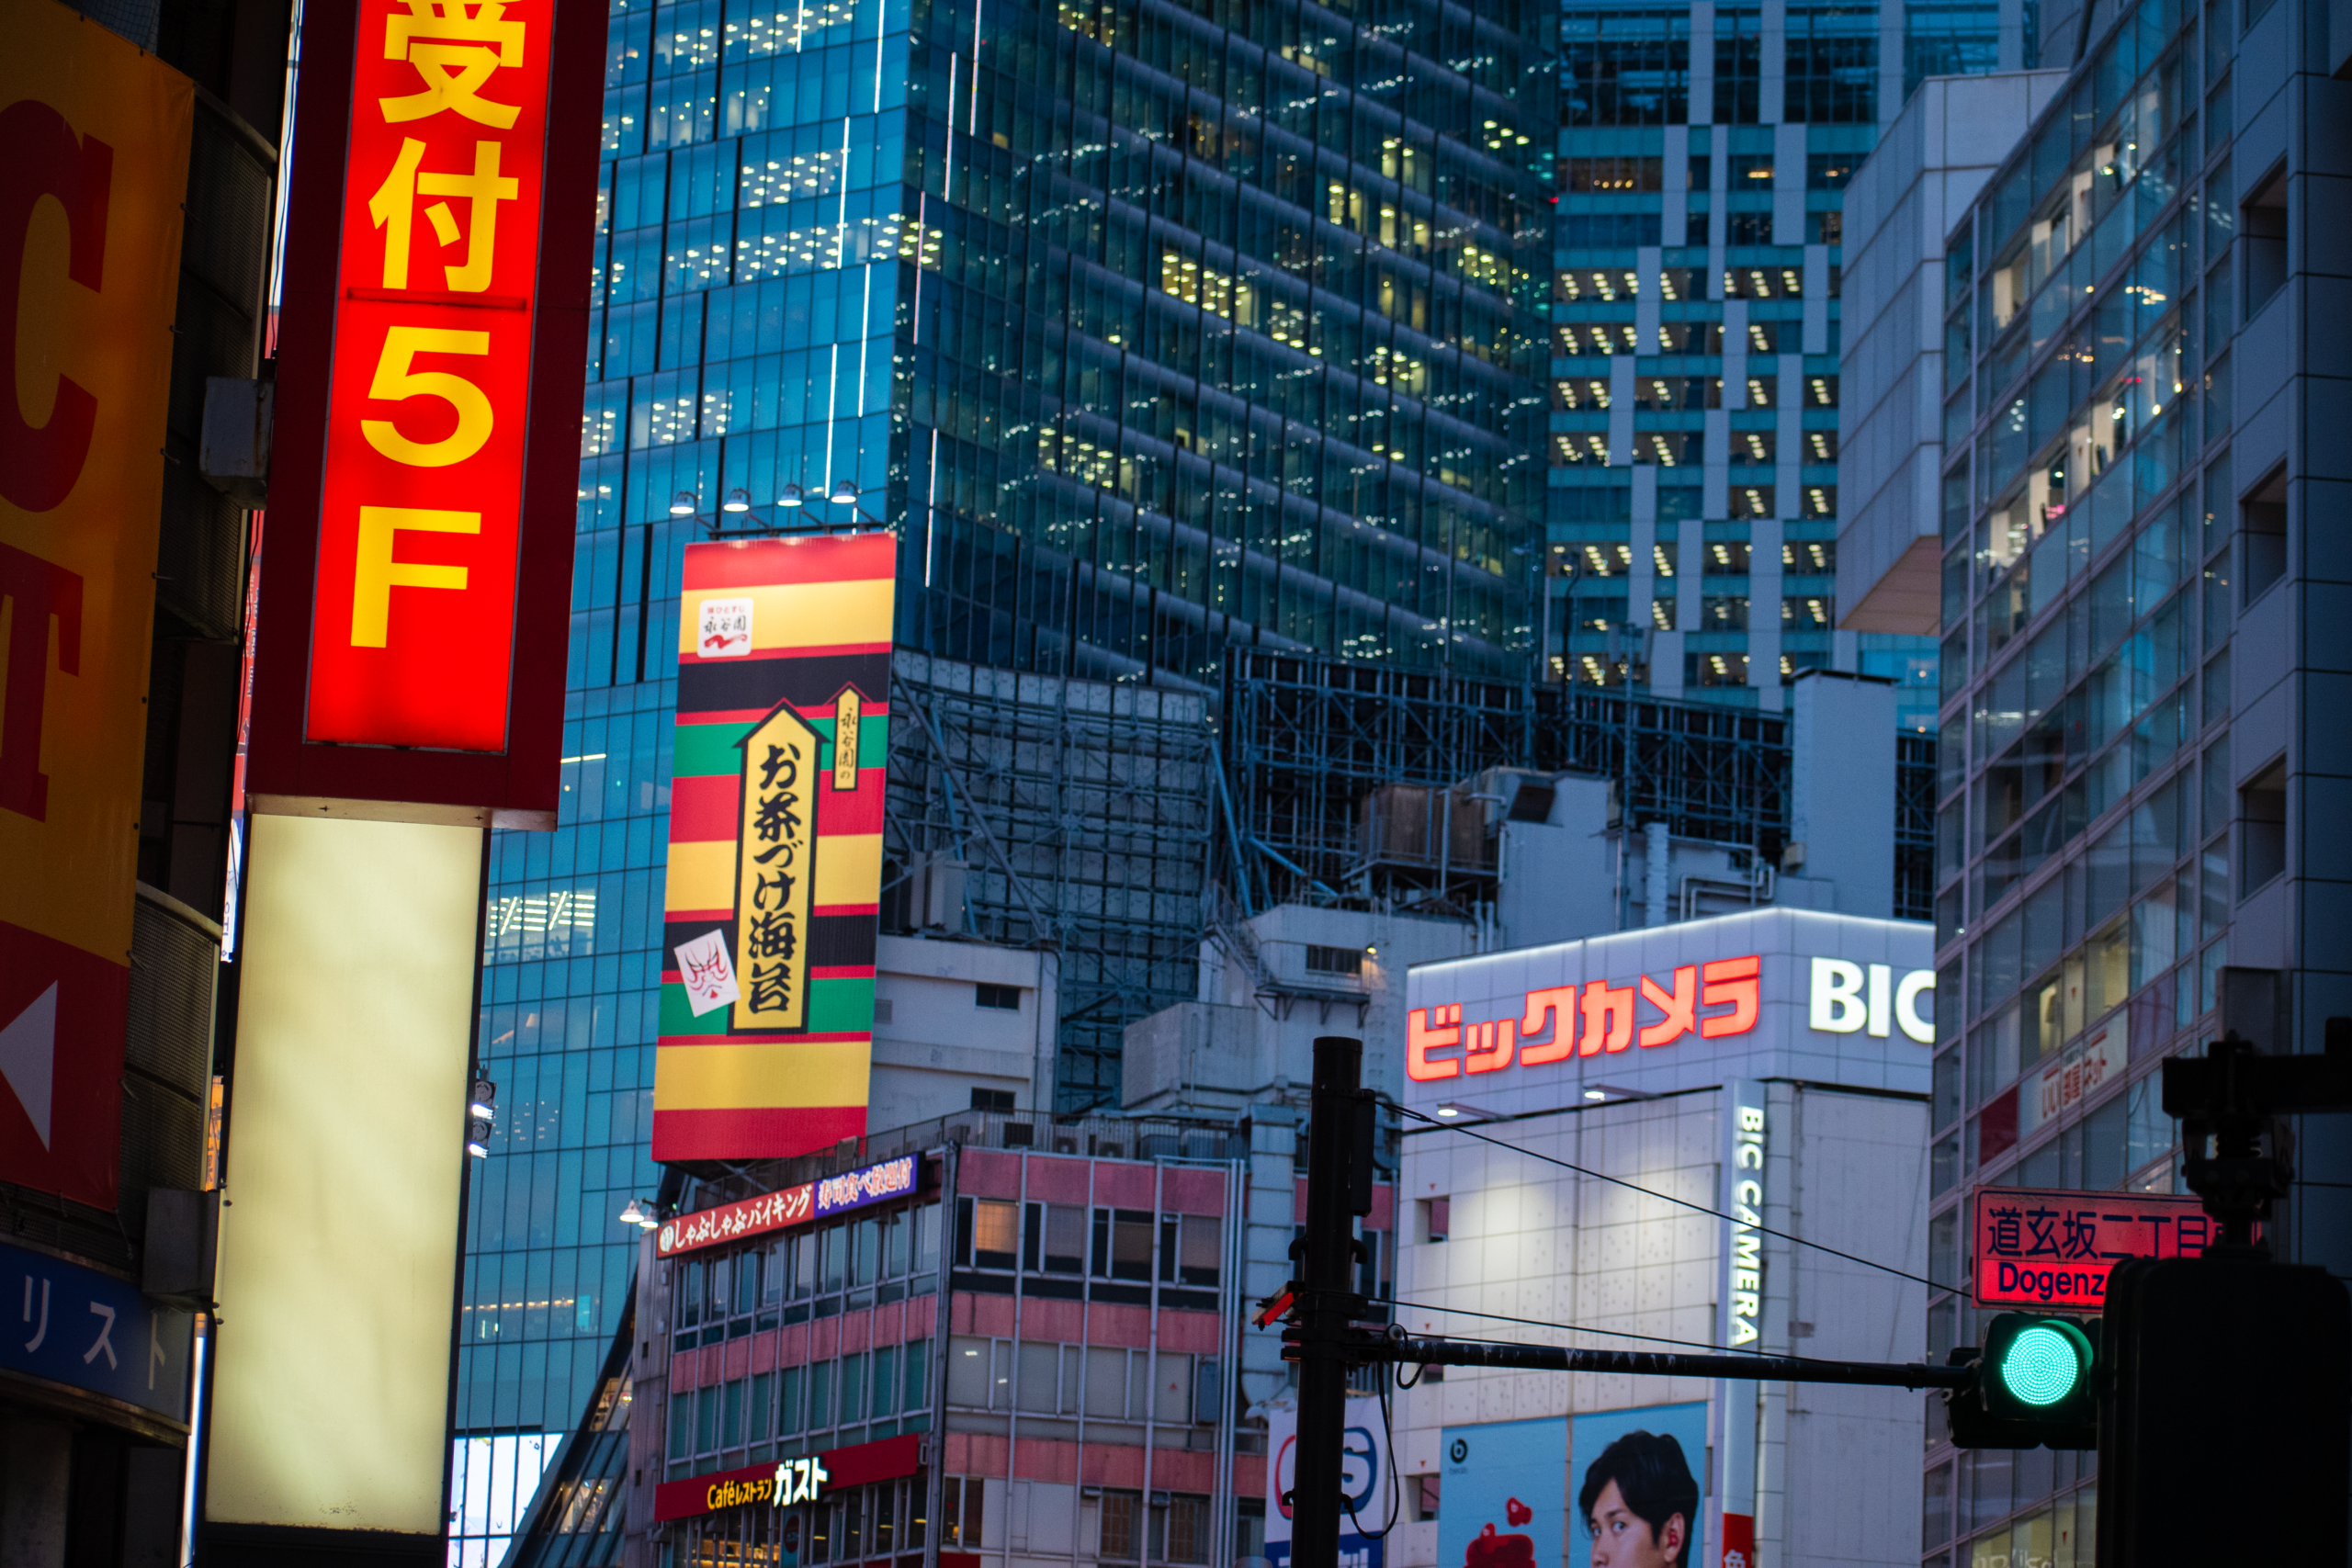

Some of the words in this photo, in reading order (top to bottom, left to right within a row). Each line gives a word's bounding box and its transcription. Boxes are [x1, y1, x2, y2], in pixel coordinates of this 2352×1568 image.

[747, 742, 805, 1014] お茶づけ海苔
[1406, 954, 1761, 1082] ビックカメラ
[1810, 956, 1936, 1043] BIC
[1736, 1106, 1764, 1171] BIC
[674, 1184, 813, 1249] しゃぶしゃぶバイキング
[1986, 1206, 2223, 1260] 道玄坂二丁目
[1731, 1179, 1763, 1347] CAMERA
[773, 1456, 828, 1508] ガスト
